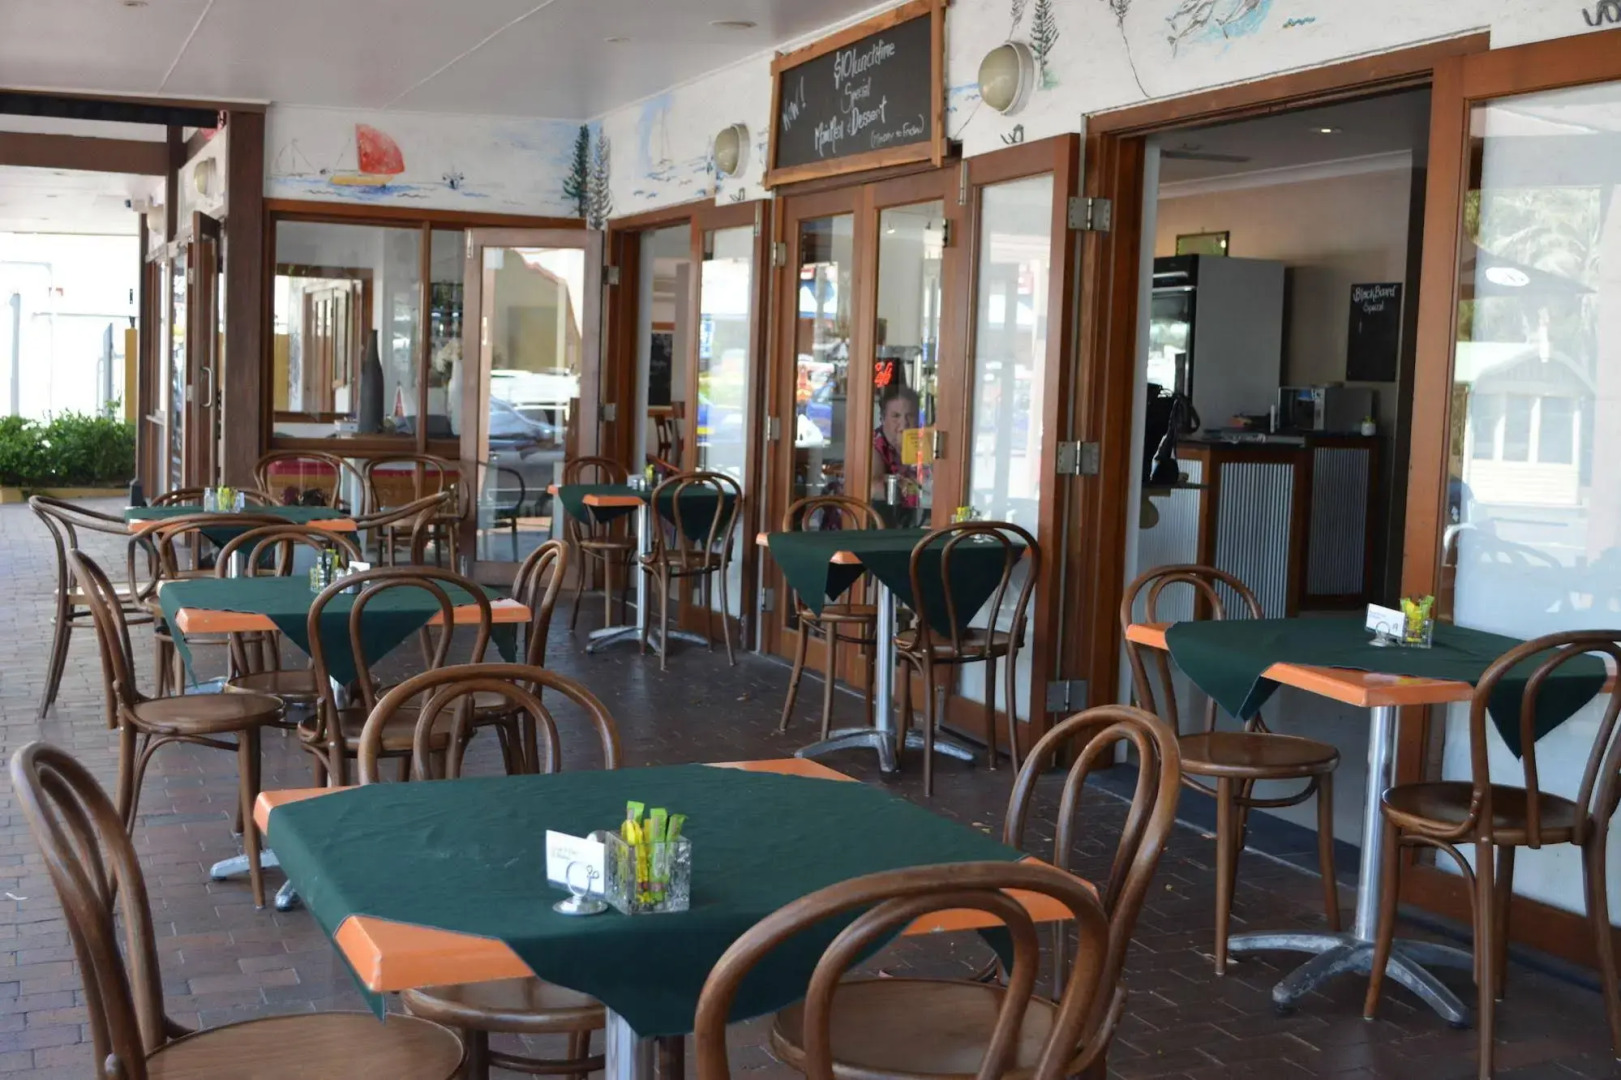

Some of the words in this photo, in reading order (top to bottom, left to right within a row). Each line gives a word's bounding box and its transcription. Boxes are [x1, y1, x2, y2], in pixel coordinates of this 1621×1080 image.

[833, 51, 852, 90] $10
[840, 76, 872, 114] Special
[850, 94, 888, 137] Dessert
